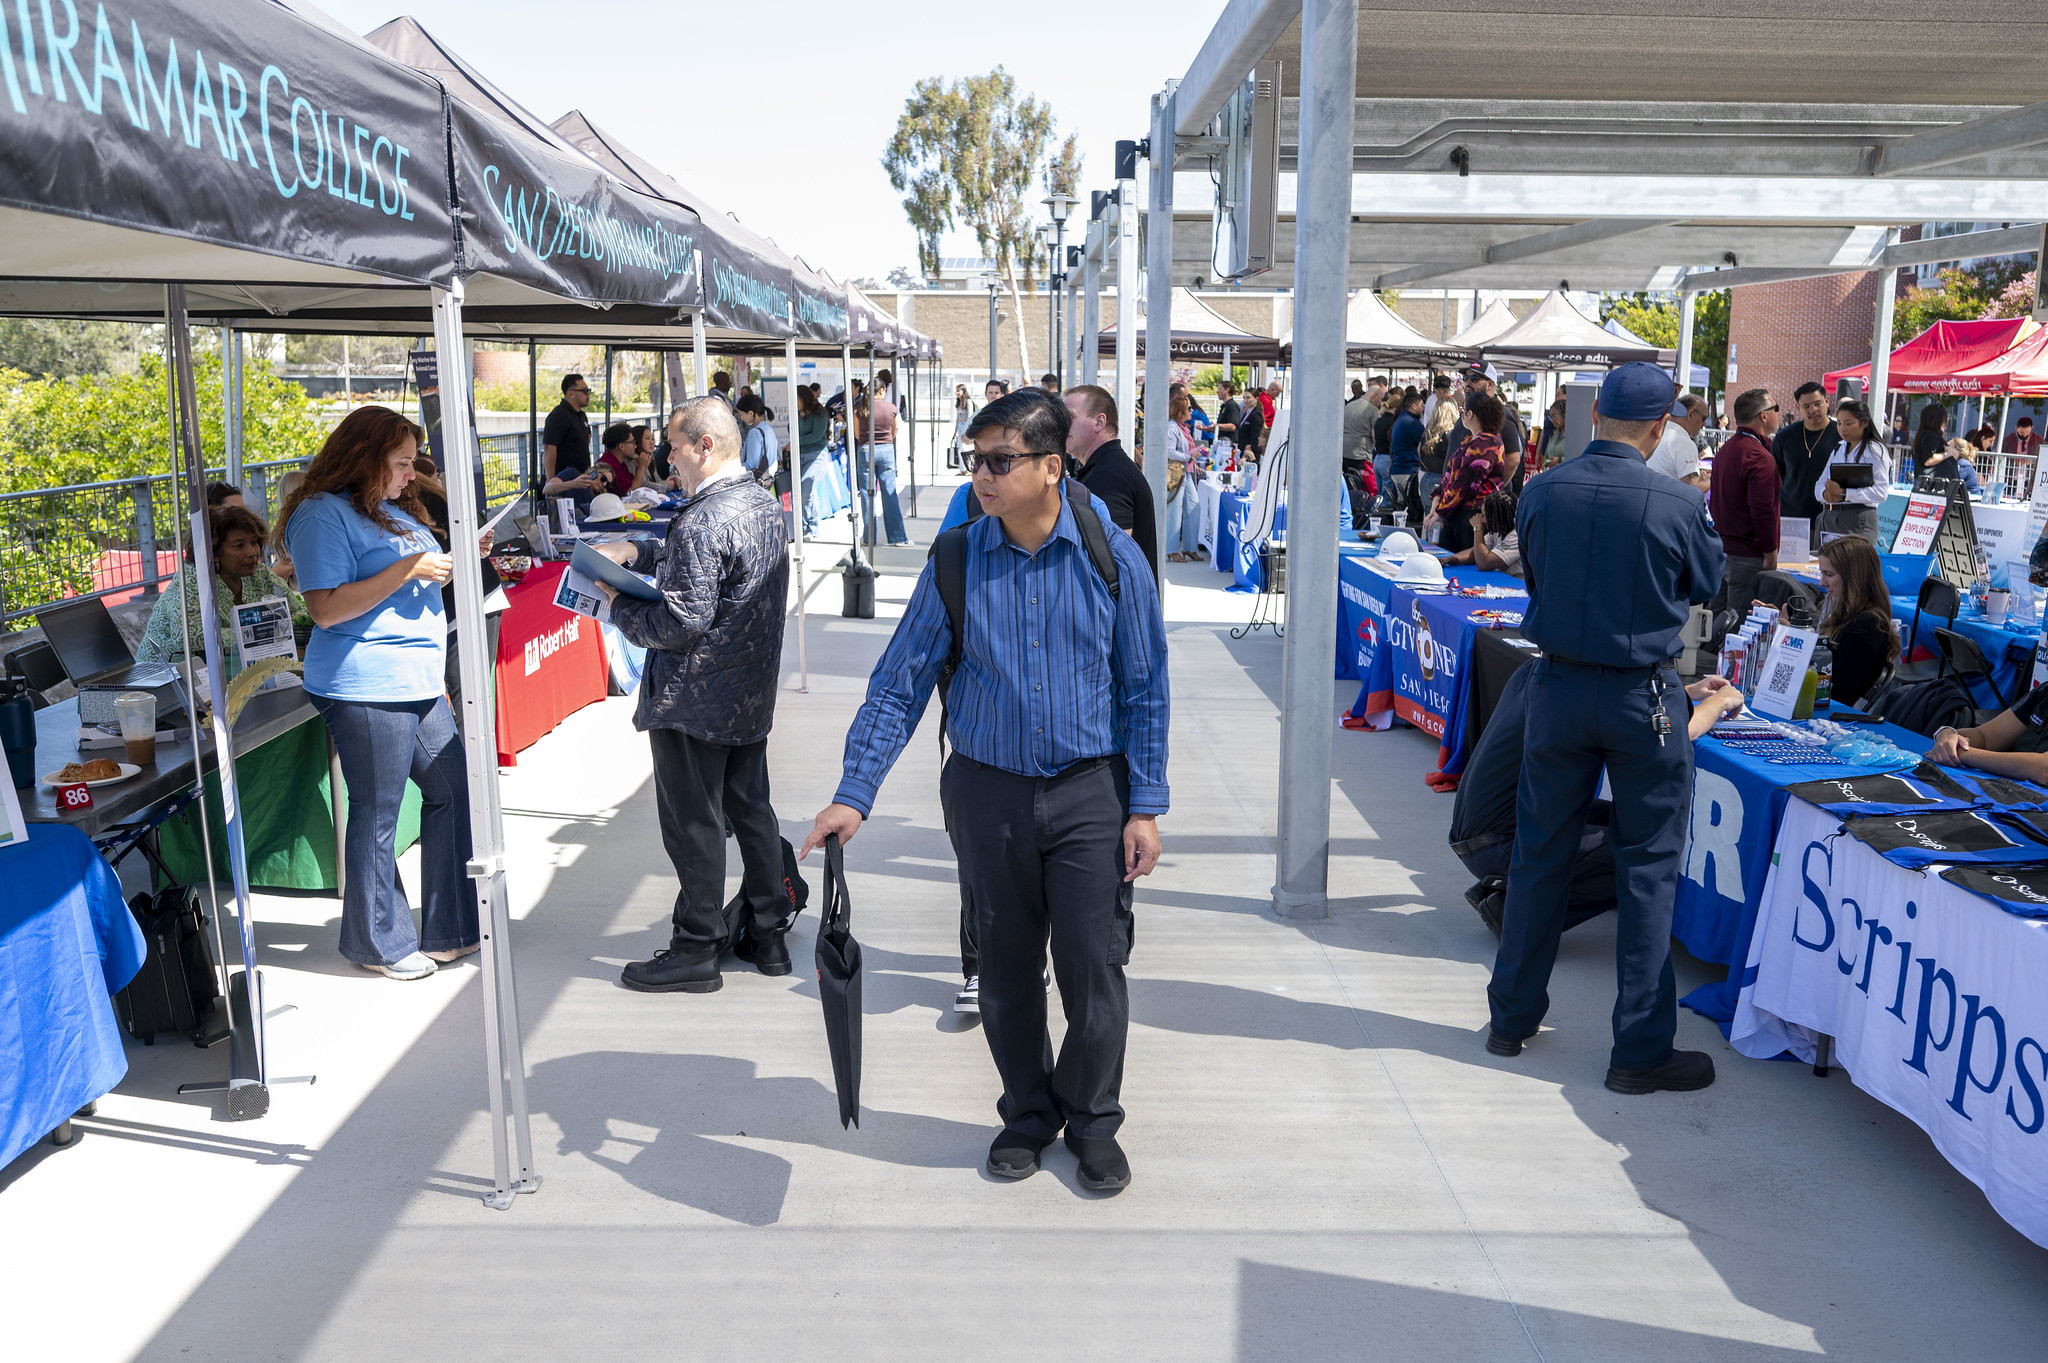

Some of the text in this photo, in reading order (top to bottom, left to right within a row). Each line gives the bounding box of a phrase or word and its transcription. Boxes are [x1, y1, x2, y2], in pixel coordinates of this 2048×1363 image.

[260, 65, 414, 221] COLLEGE
[484, 165, 695, 280] SAN DIEGO MIRAMAR COLLEGE
[1180, 342, 1200, 354] CITY
[1904, 522, 1935, 536] EMPLOYER
[1901, 536, 1926, 549] SECTION
[540, 630, 565, 661] Robert
[565, 614, 581, 646] Half
[1401, 673, 1421, 697] SAN
[65, 787, 90, 805] 86
[1791, 840, 2048, 1135] Scripps
